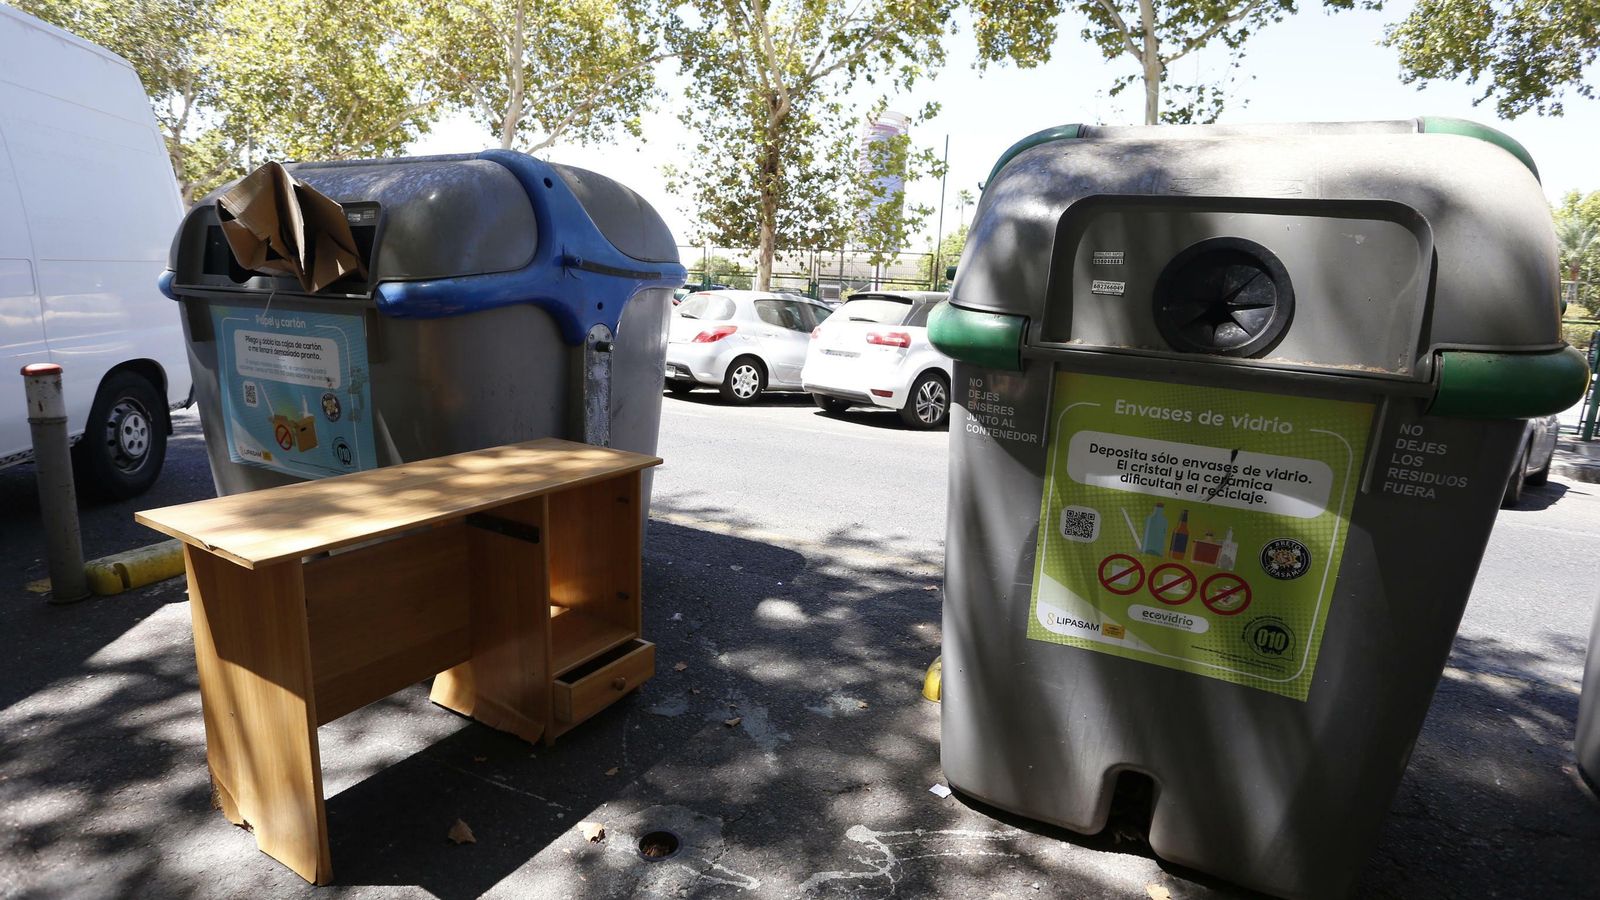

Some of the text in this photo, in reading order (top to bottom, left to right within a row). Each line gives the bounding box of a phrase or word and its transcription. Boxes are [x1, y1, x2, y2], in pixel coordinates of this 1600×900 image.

[281, 317, 306, 328] cartón
[295, 341, 302, 349] de
[969, 377, 983, 388] NO
[968, 389, 1000, 402] DEJES
[967, 400, 1015, 416] ENSERES
[966, 413, 1016, 428] JUNTO AL
[1114, 399, 1293, 434] Envases de vidrio
[966, 423, 1038, 443] CONTENEDOR
[1399, 423, 1424, 436] NO
[1395, 438, 1447, 455] DEJES
[1089, 443, 1312, 484] Deposita sólo envases de vidrio.
[1391, 453, 1425, 467] LOS
[1117, 459, 1273, 492] El cristal y la cerámica
[1387, 467, 1468, 488] RESIDUOS
[1120, 473, 1268, 505] dificultan el reciclaje.
[1383, 481, 1436, 499] FUERA
[1265, 563, 1300, 578] LIPASAM
[1056, 616, 1100, 632] LIPASAM
[1142, 609, 1193, 627] ecovidrio
[1256, 628, 1287, 651] 010
